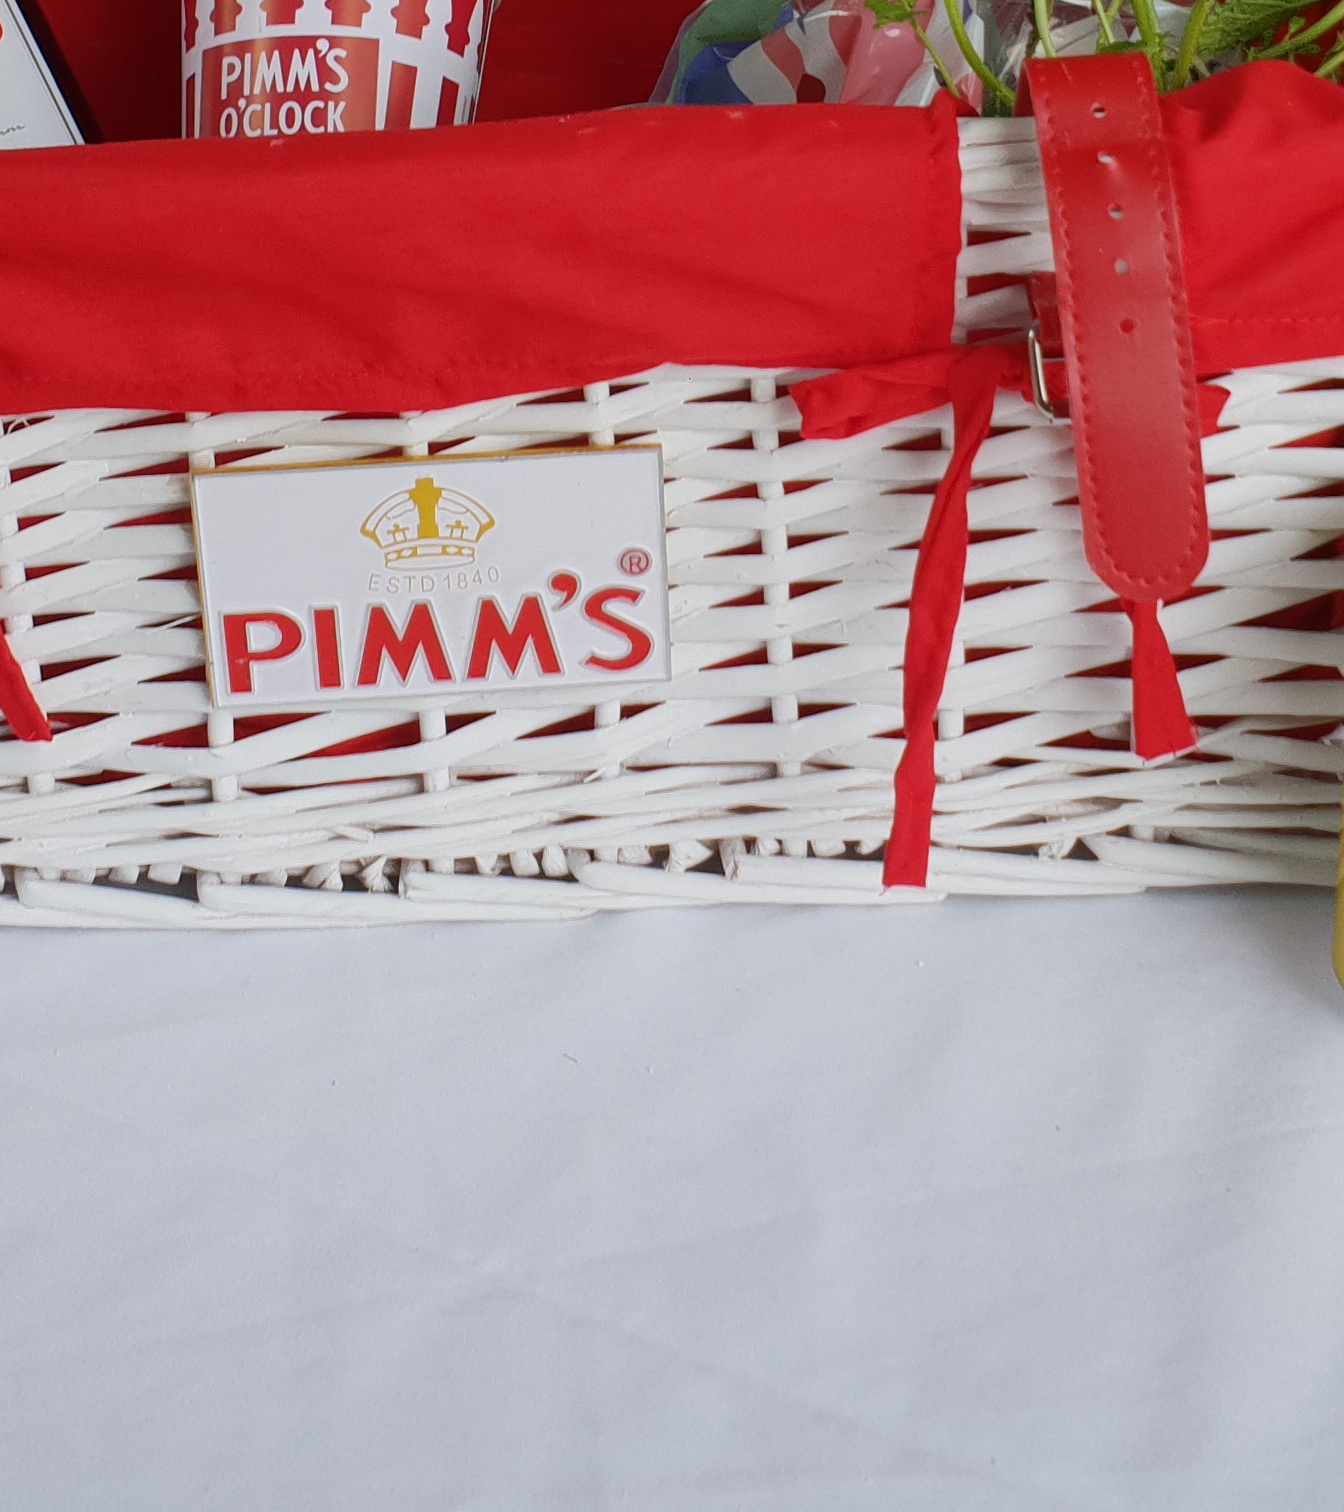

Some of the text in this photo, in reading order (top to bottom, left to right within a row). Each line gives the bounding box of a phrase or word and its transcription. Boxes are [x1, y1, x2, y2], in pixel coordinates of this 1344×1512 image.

[220, 38, 349, 100] PIMM'S
[219, 97, 347, 138] O'CLOCK
[367, 565, 500, 594] ESTD 1840
[219, 570, 655, 695] PIMM'S
